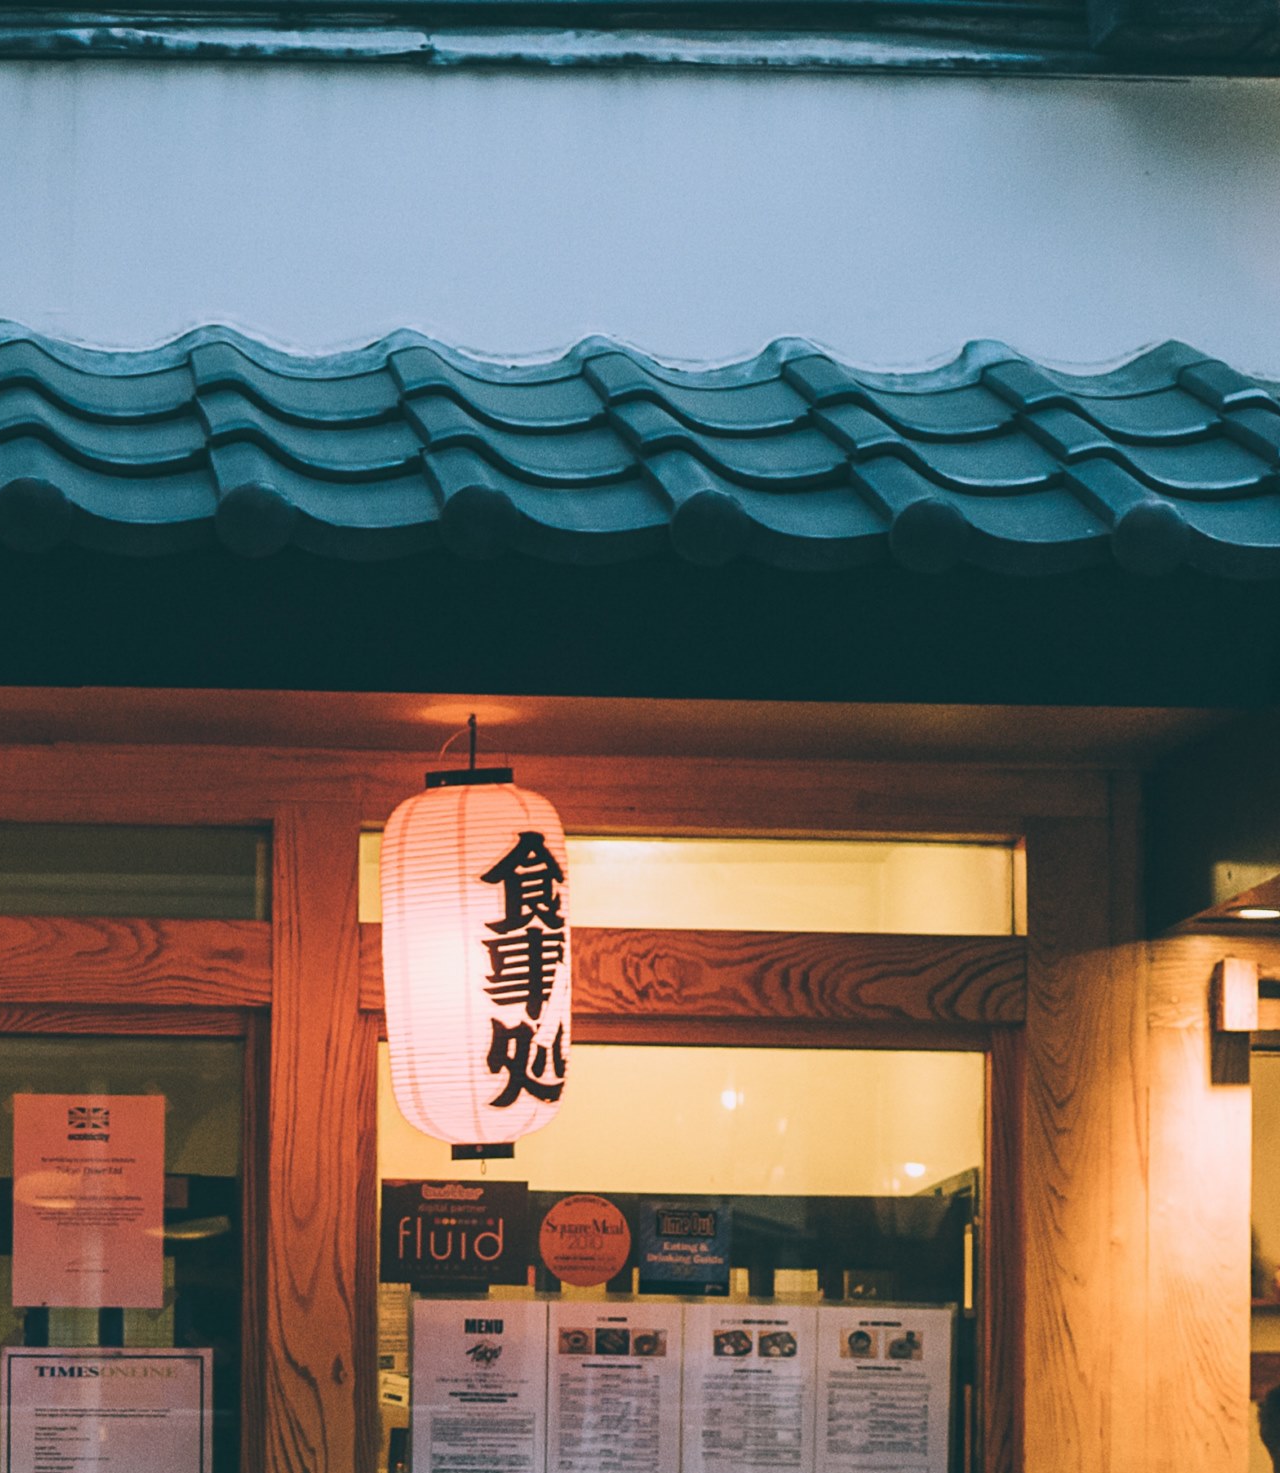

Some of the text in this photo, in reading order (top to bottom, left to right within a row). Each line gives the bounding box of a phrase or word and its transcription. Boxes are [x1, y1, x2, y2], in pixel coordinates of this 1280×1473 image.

[481, 831, 571, 1109] 食事処
[421, 1184, 484, 1200] twitter
[418, 1203, 487, 1214] digital partner
[660, 1212, 716, 1237] Time Out
[399, 1216, 504, 1261] fluid
[663, 1241, 698, 1253] Eating
[646, 1254, 724, 1265] Drinking Guide
[465, 1318, 504, 1335] MENU
